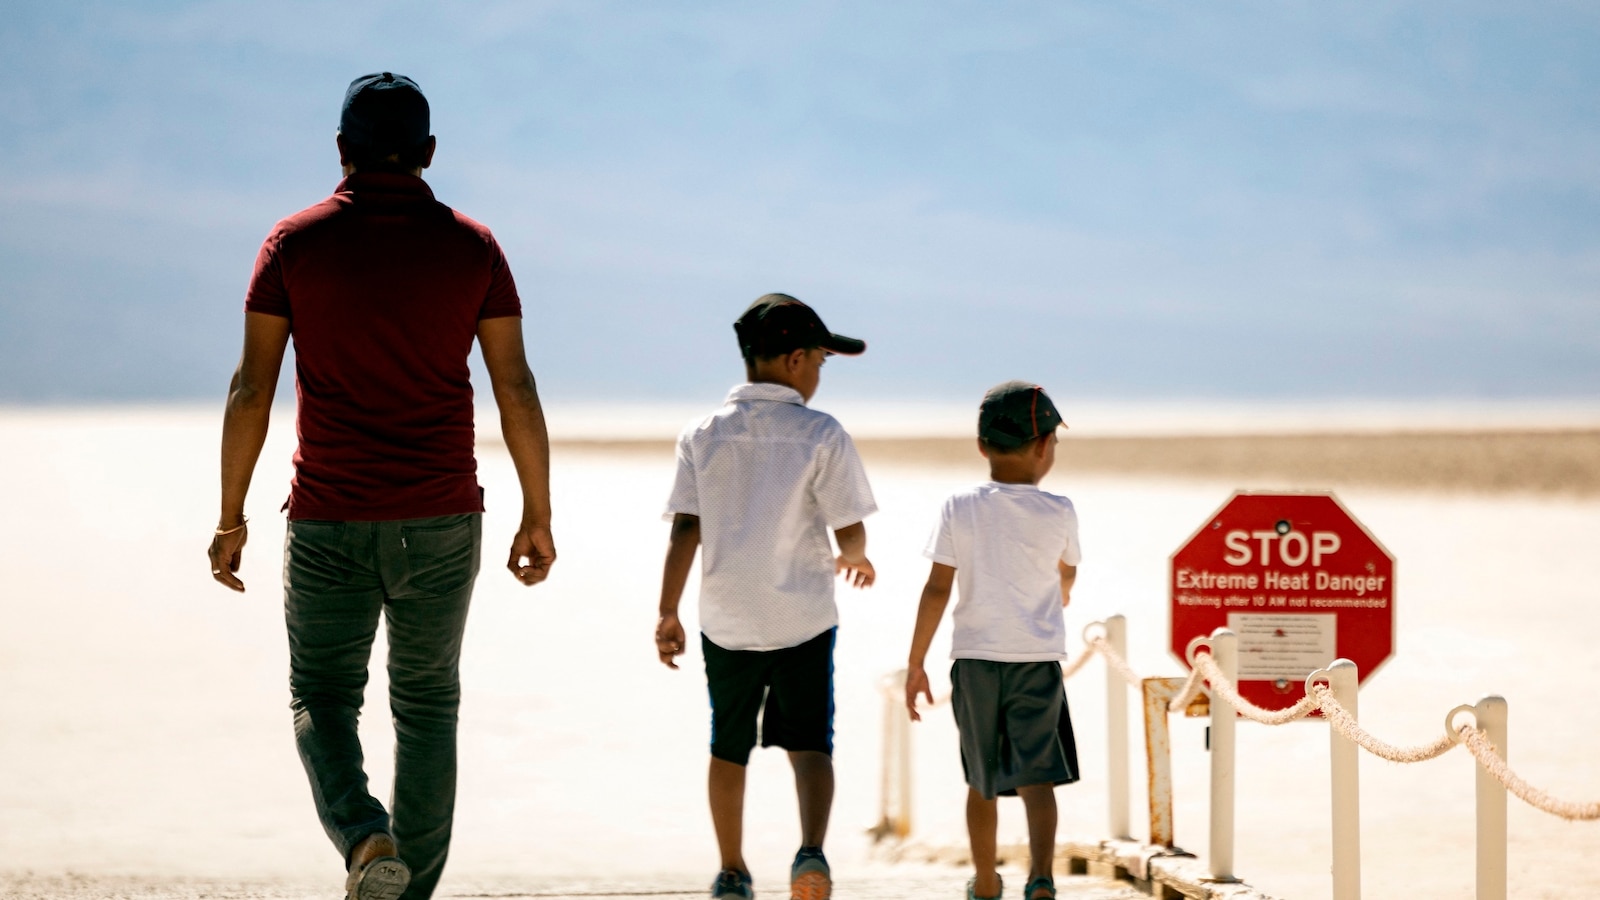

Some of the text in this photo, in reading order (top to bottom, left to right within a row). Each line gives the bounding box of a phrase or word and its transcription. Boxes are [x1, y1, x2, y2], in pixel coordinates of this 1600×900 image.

[1223, 530, 1341, 567] STOP
[1176, 571, 1386, 596] Extreme Heat Danger
[1177, 595, 1388, 609] Walking after 10 AM not recommended
